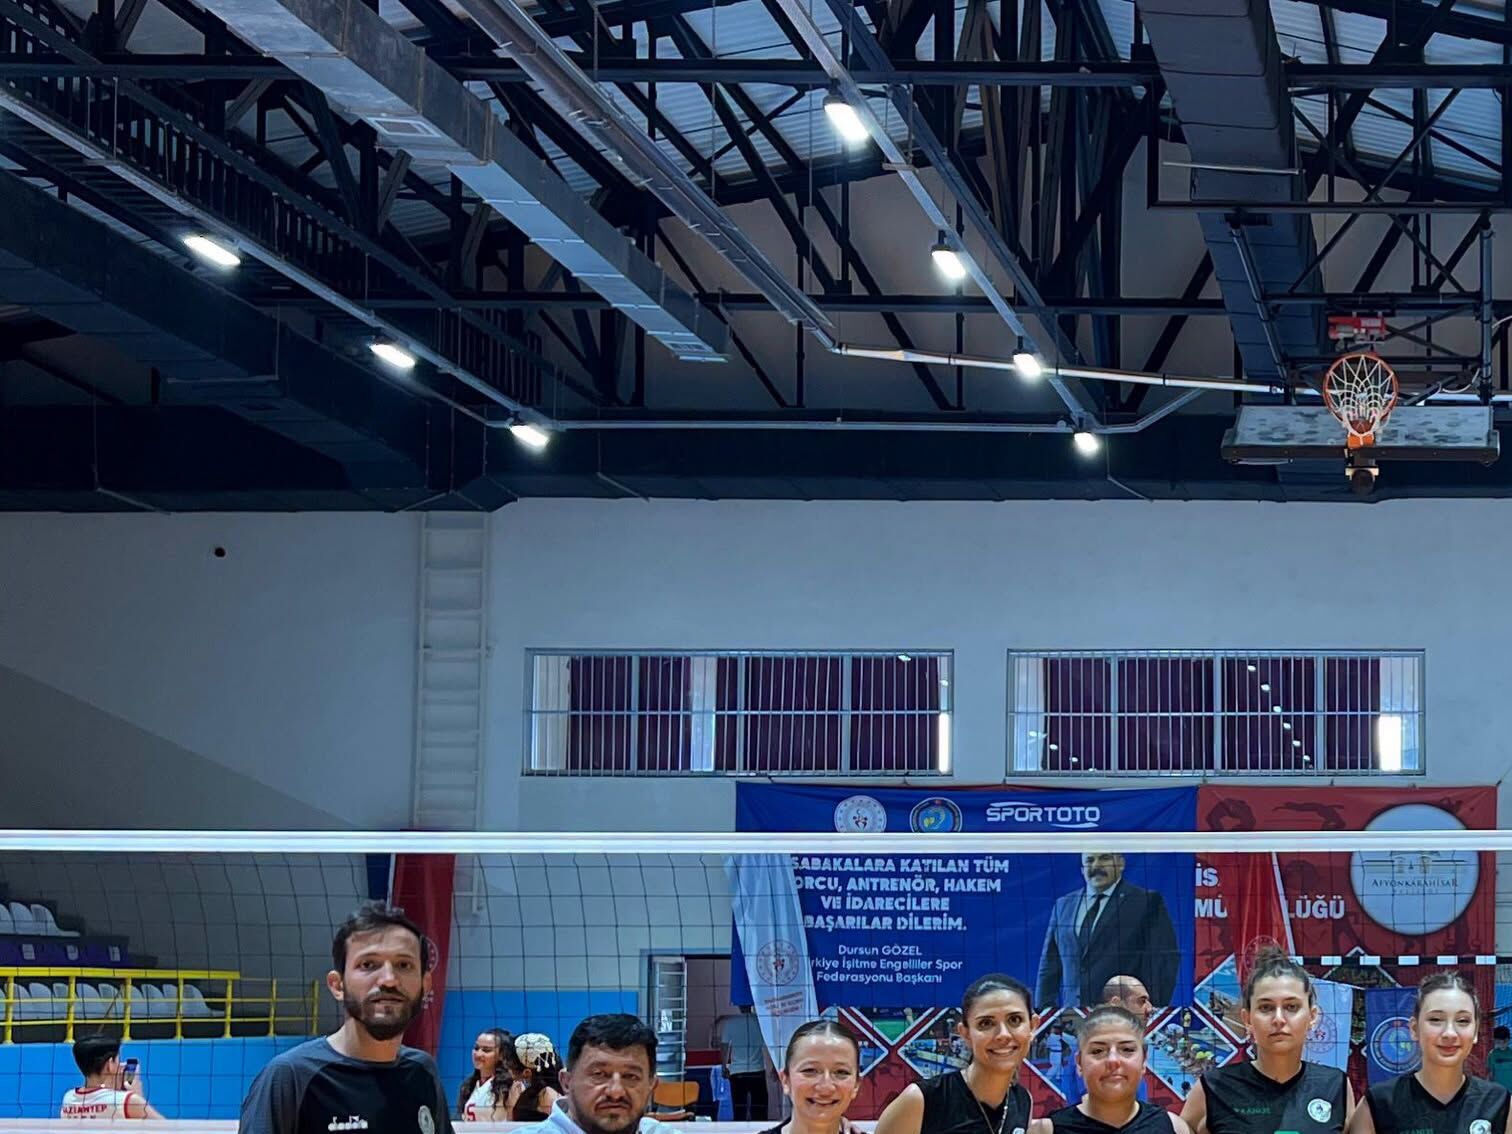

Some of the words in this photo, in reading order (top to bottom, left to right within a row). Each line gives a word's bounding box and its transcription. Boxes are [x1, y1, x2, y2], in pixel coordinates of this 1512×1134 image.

[986, 804, 1101, 825] SPORTOTO
[791, 856, 896, 872] SABAKALARA
[900, 859, 969, 873] KATILAN
[973, 856, 1009, 873] TÜM
[794, 876, 842, 892] ORCU,
[846, 874, 940, 893] ANTRENÖR,
[944, 878, 1001, 892] HAKEM
[820, 896, 842, 910] VE
[803, 915, 893, 932] BAŞARILAR
[896, 912, 967, 931] DİLERİM.
[838, 945, 879, 956] Dursun
[811, 959, 839, 971] rkiye
[936, 960, 963, 972] Spor
[816, 971, 893, 984] Federasyonu
